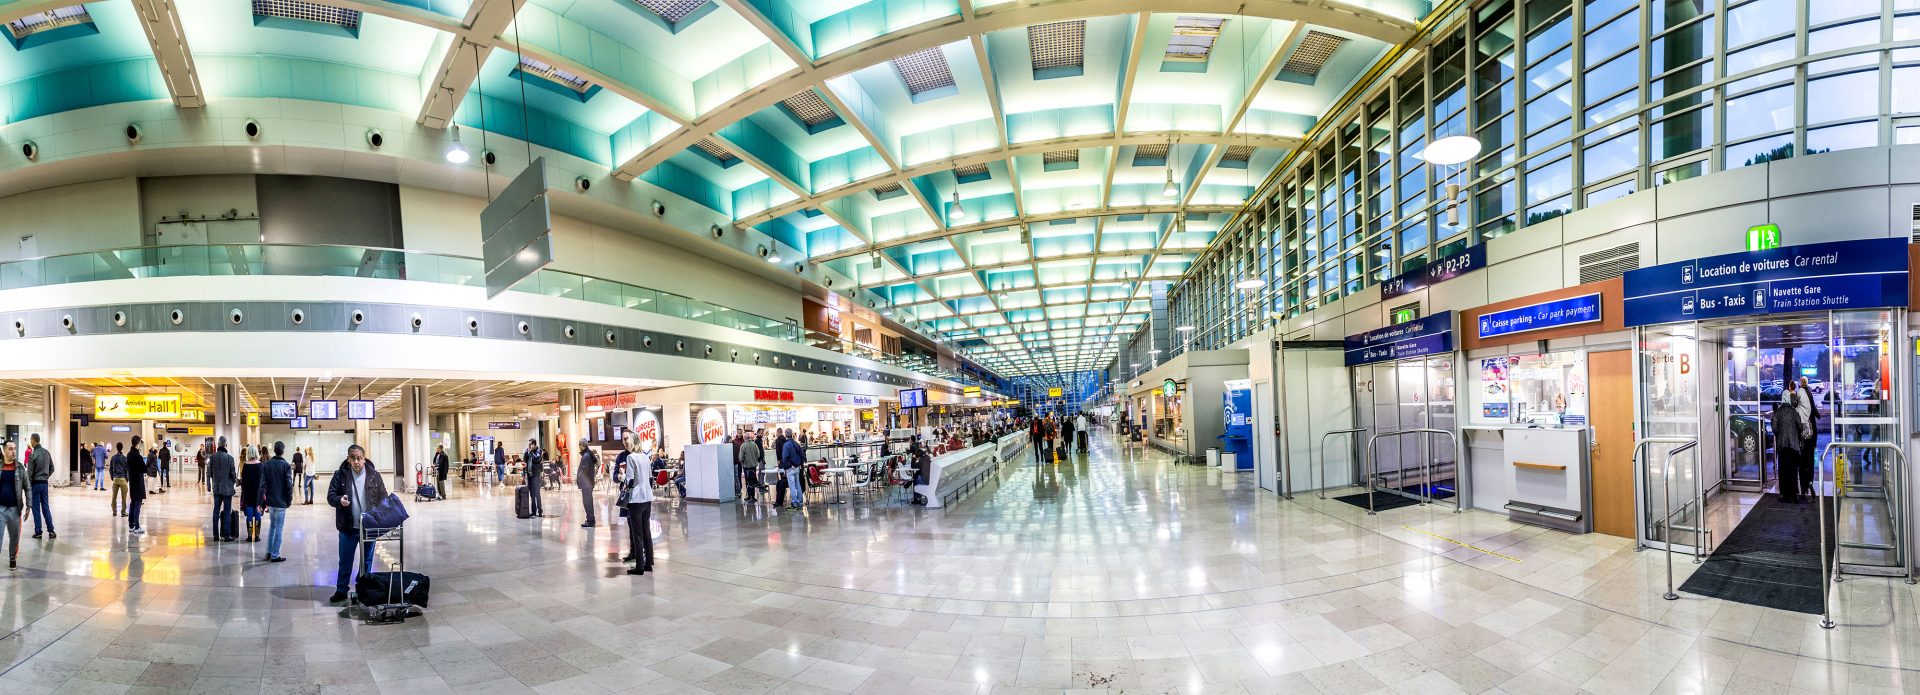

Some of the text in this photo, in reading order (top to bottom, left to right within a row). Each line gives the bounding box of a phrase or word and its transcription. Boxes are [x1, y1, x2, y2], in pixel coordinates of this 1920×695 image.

[1446, 253, 1471, 273] P2-P3
[1700, 252, 1838, 278] Location de voitures Car rental
[1396, 279, 1404, 291] P1
[1773, 285, 1821, 297] Navette Gare
[1700, 298, 1716, 309] Bus
[1723, 294, 1746, 307] Taxis
[1773, 295, 1849, 308] Train Station Shuttle
[1492, 320, 1509, 328] Caisse
[1510, 315, 1532, 327] parking
[1537, 312, 1548, 320] Car
[1549, 308, 1564, 320] park
[1565, 304, 1594, 316] payment
[1369, 333, 1385, 342] Location
[1389, 329, 1404, 338] voitures
[1652, 353, 1690, 374] Sortie B
[754, 389, 794, 401] BURGER KING
[149, 400, 169, 413] Hall
[171, 400, 177, 414] 1
[703, 420, 721, 432] BUR
[640, 428, 656, 442] ING
[703, 425, 724, 443] KING
